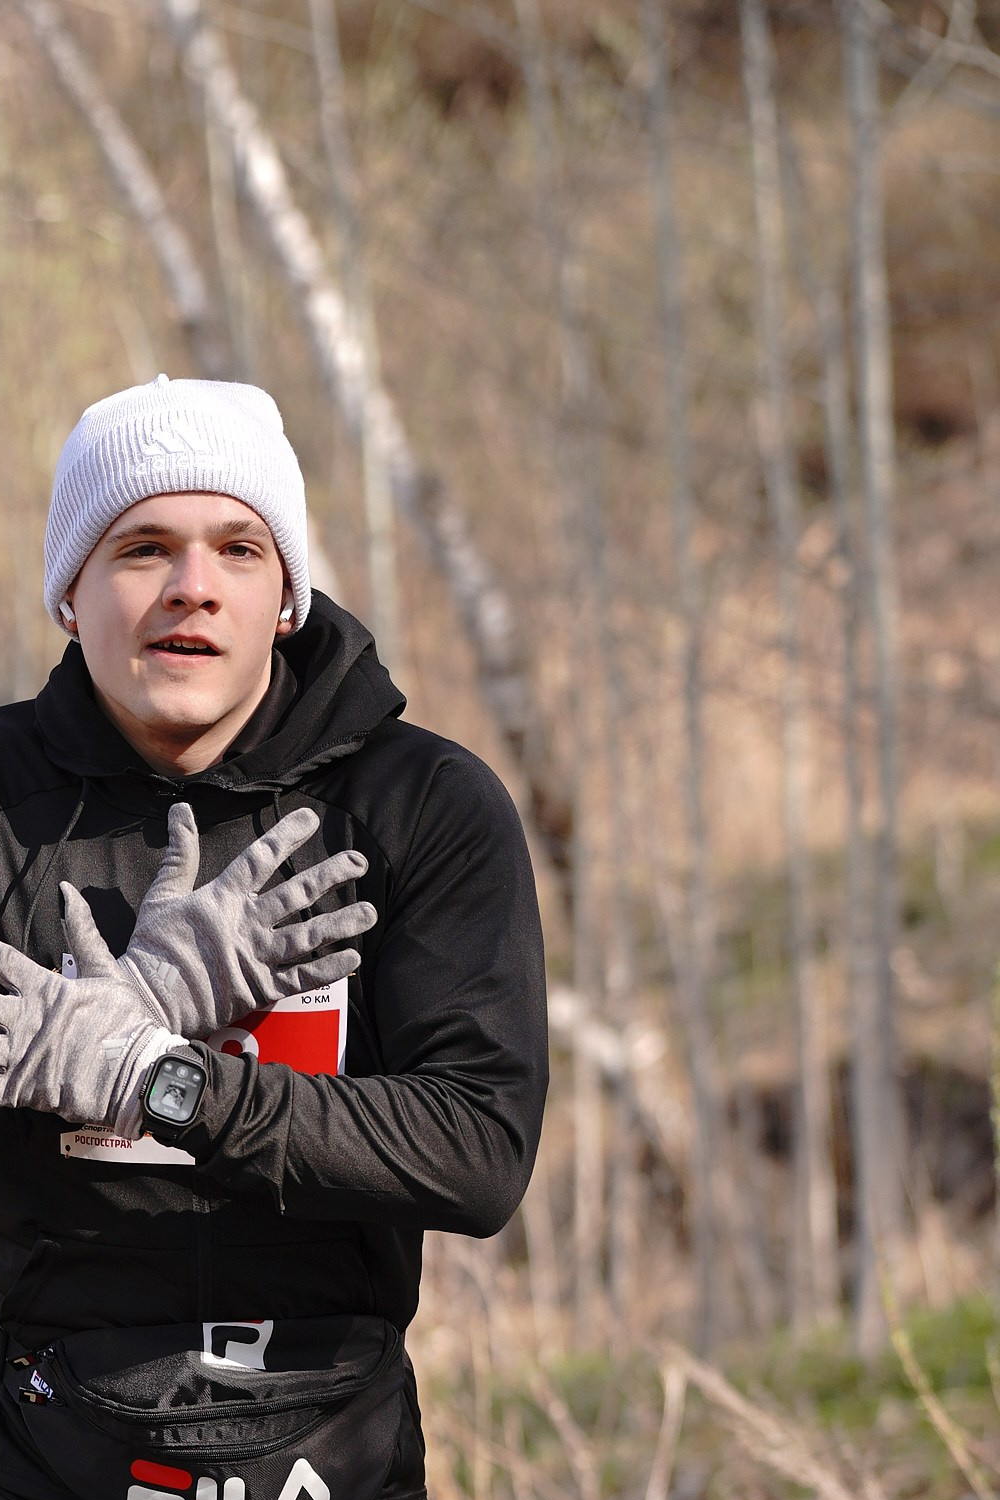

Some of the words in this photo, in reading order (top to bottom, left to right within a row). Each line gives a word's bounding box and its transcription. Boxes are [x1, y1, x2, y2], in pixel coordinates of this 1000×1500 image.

[134, 453, 230, 476] adid
[301, 995, 311, 1004] 10
[74, 1134, 133, 1149] РОСГОССТРАХ
